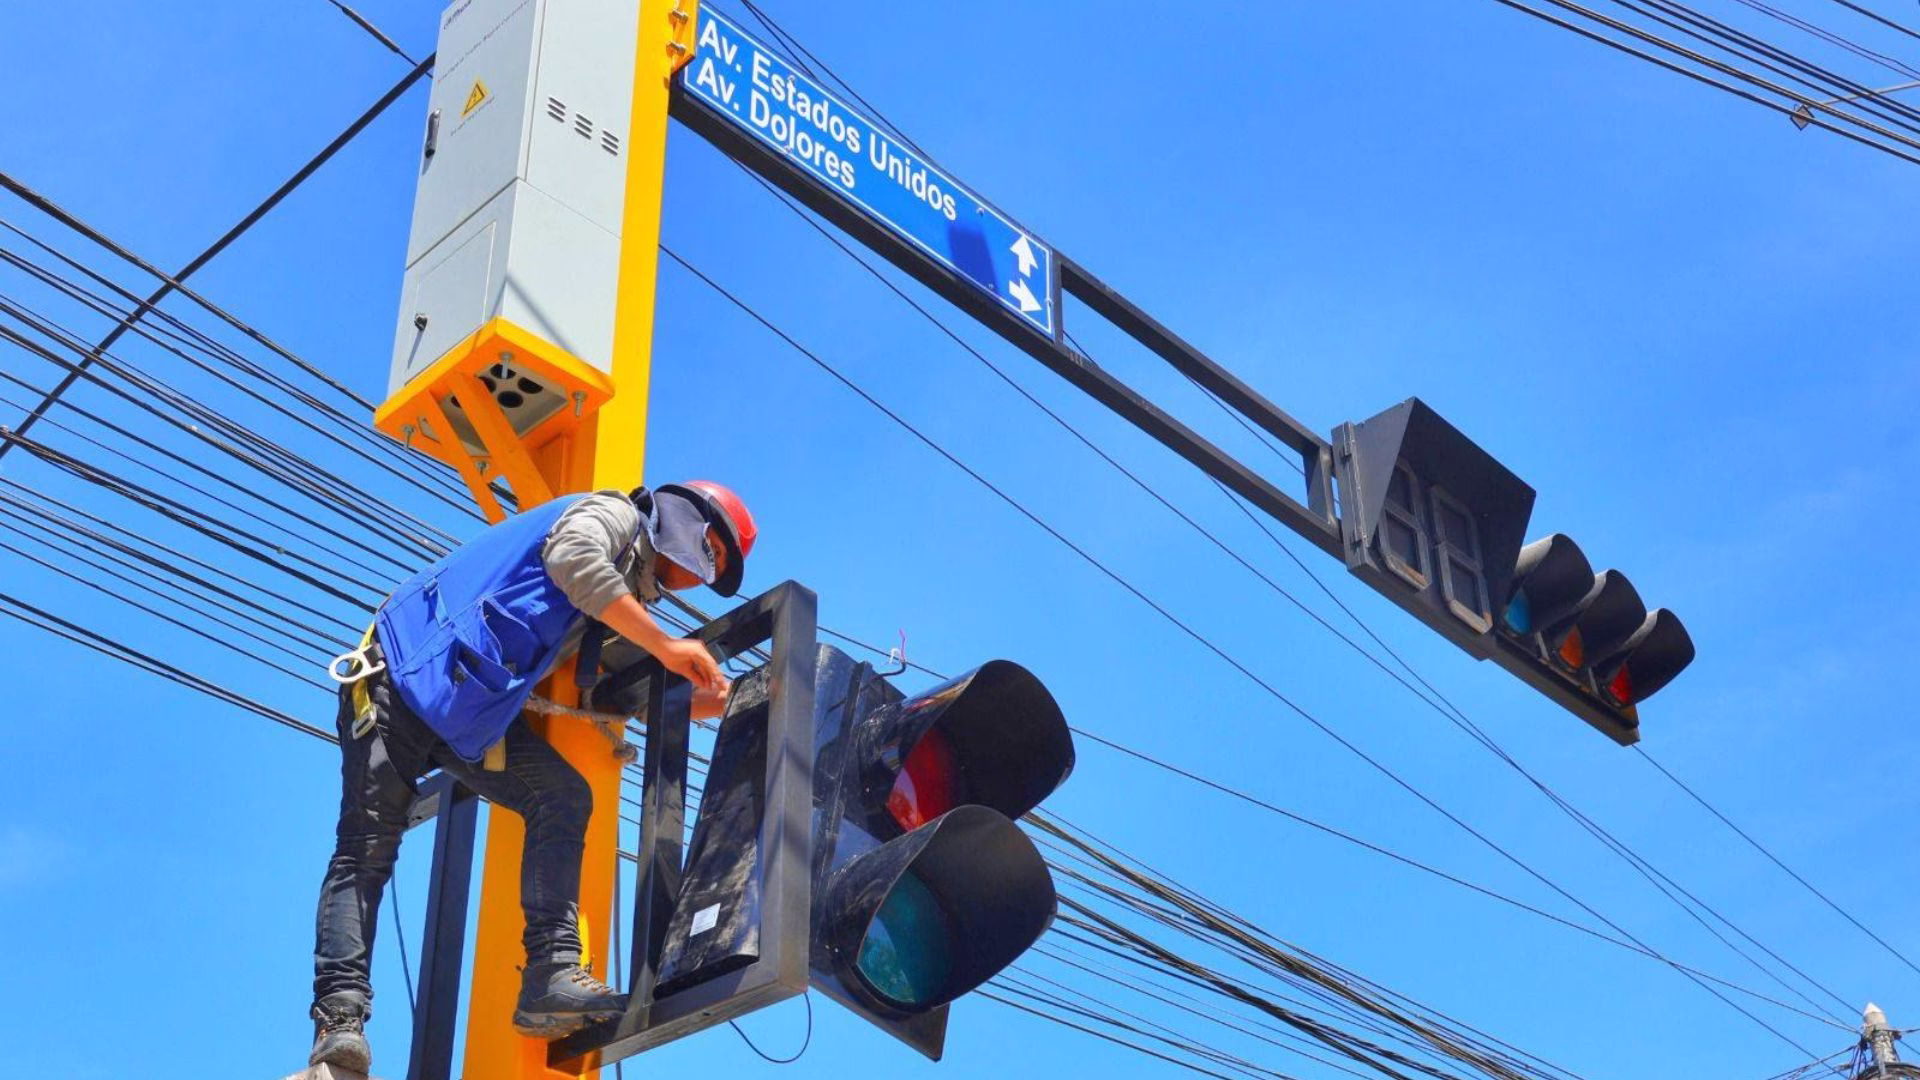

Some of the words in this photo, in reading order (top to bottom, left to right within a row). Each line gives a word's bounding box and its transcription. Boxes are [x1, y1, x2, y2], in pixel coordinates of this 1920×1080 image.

[696, 57, 739, 111] Av.
[750, 89, 855, 188] Dolores
[700, 19, 741, 72] Av.
[752, 51, 860, 153] Estados
[869, 133, 957, 220] Unidos
